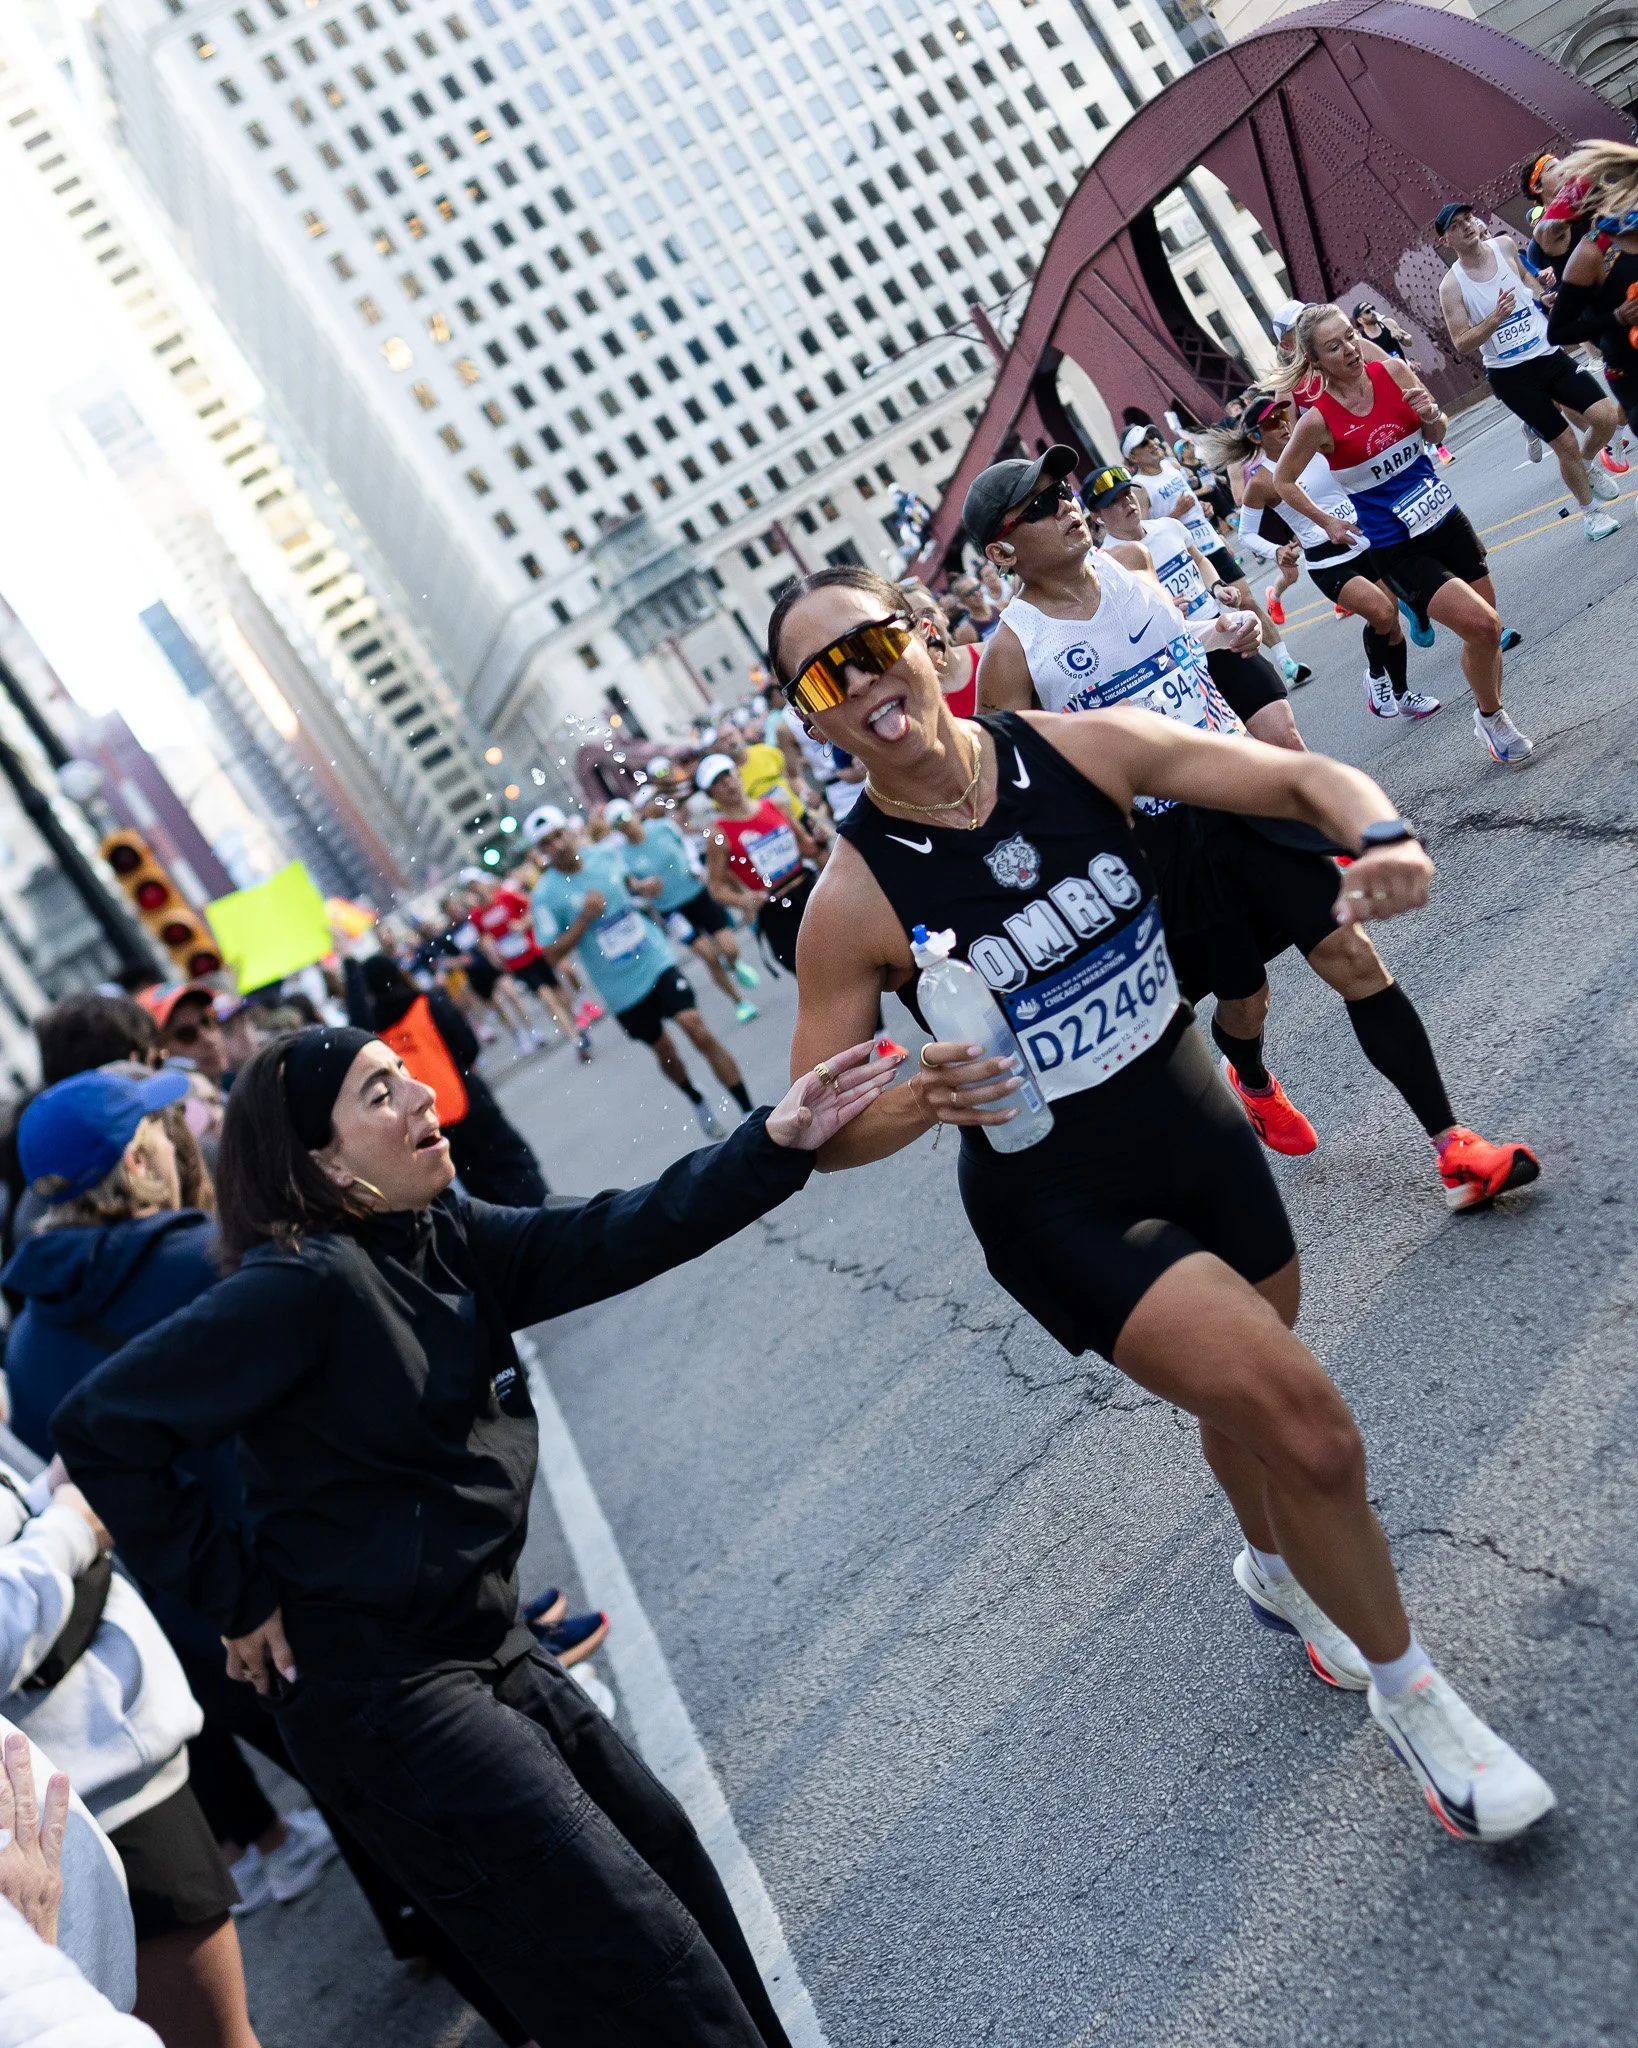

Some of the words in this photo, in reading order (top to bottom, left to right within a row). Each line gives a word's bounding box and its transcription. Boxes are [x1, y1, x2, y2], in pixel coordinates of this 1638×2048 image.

[1496, 319, 1531, 345] E8945
[1370, 441, 1420, 480] PARRY
[1057, 661, 1083, 679] CHICAGO
[1104, 687, 1127, 701] CHICAGO
[1126, 670, 1154, 691] MARATHON
[969, 852, 1142, 993] OMRC
[1044, 981, 1082, 1008] CHICAGO
[1081, 952, 1127, 987] MARATHON
[1026, 944, 1168, 1073] D22468
